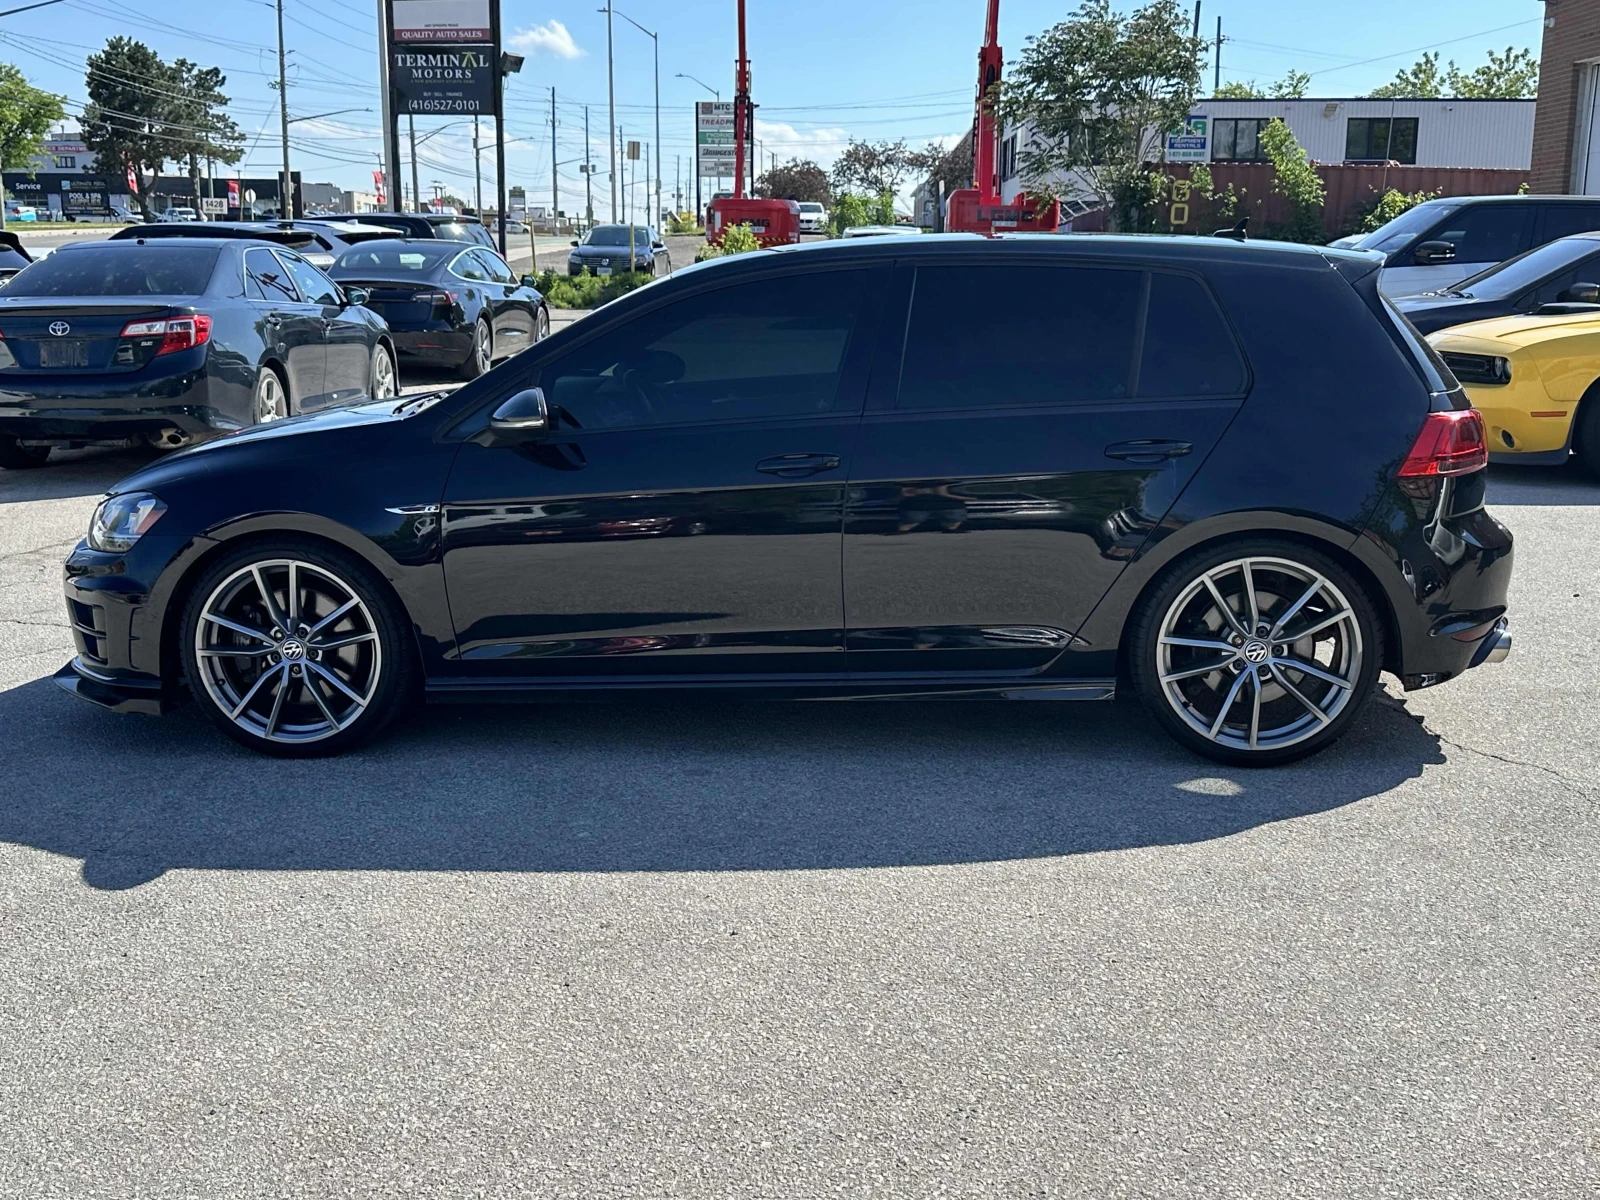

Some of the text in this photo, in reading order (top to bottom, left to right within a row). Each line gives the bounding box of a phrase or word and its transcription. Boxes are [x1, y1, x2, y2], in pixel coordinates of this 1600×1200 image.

[401, 30, 482, 39] QUALITY AUTO SALES
[394, 52, 489, 68] TERMINAL
[412, 69, 472, 79] MOTORS
[408, 100, 480, 111] (416)527-0101
[15, 182, 41, 190] Service
[205, 200, 223, 208] 1428
